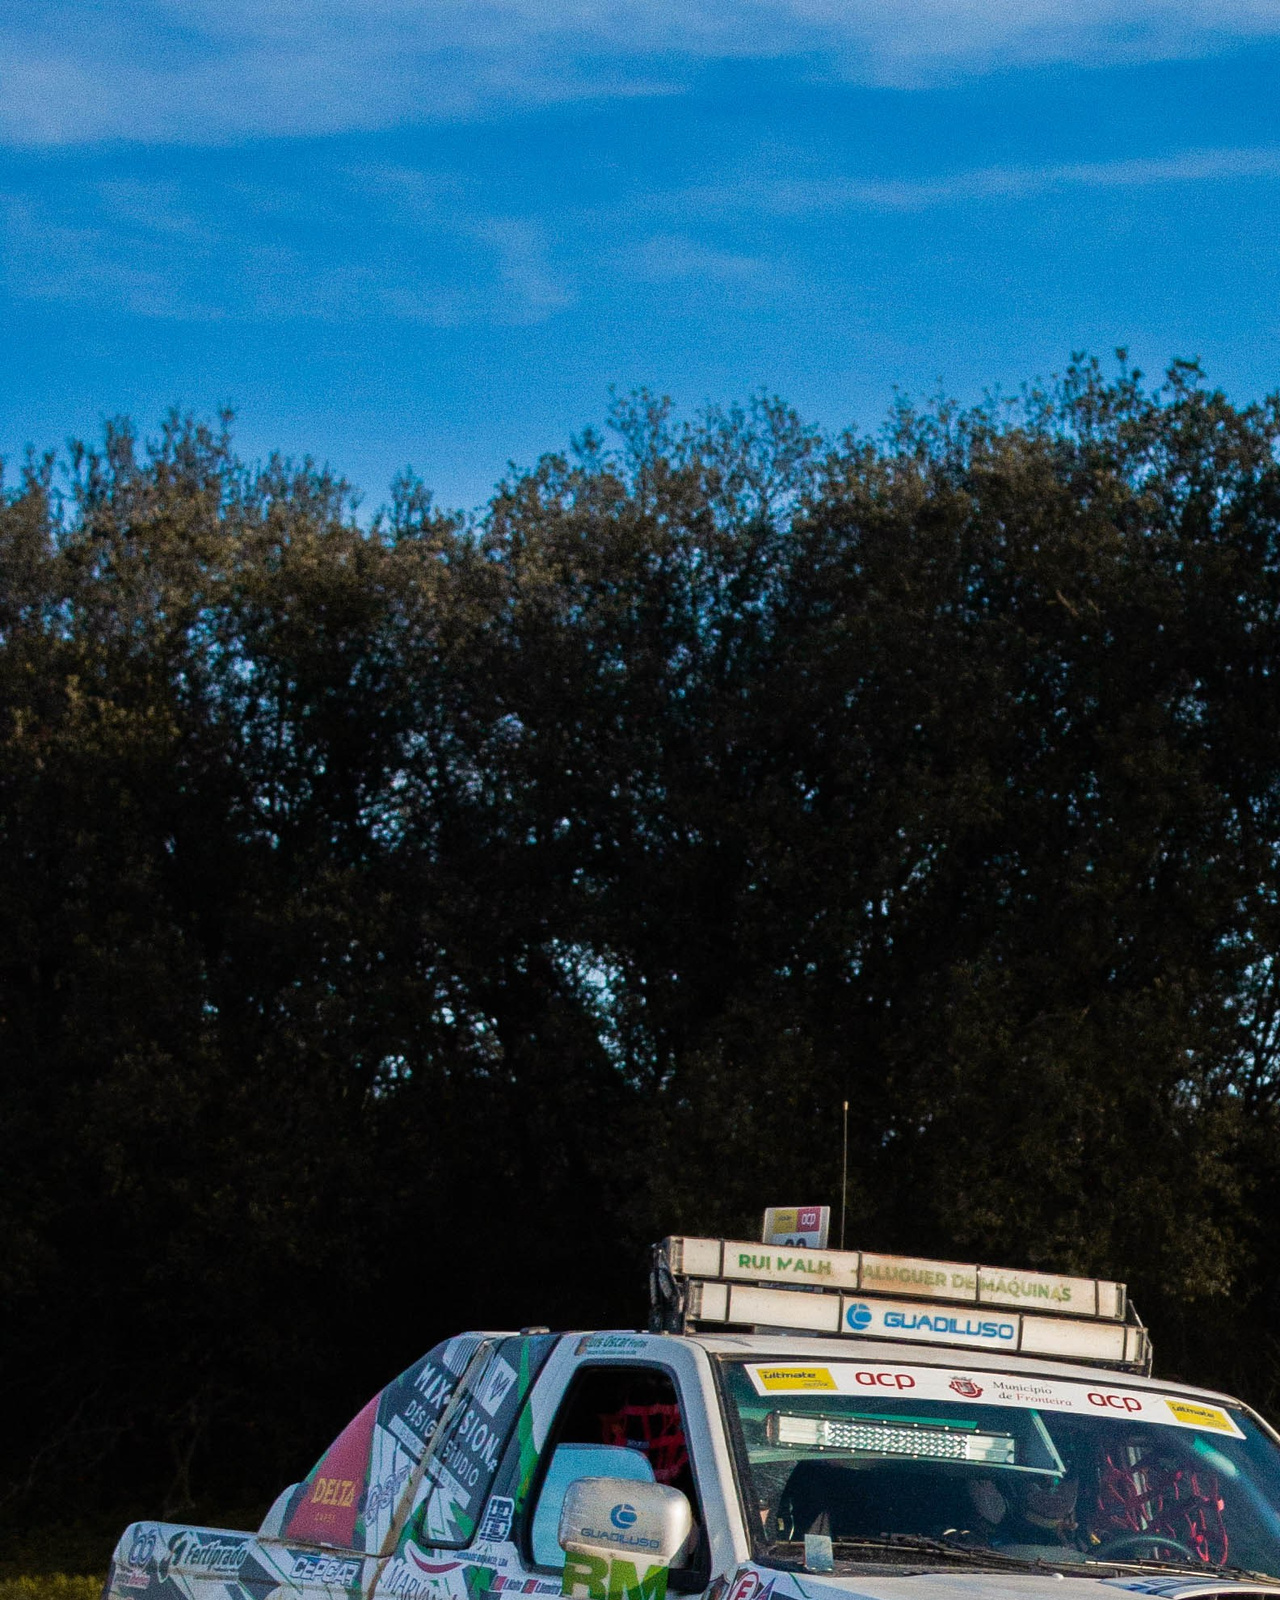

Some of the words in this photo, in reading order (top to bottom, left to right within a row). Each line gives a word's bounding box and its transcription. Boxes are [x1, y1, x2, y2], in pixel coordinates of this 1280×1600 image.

[738, 1253, 771, 1270] RUI
[884, 1311, 1014, 1340] GUADILUSO
[763, 1370, 817, 1380] ultimate
[855, 1371, 916, 1390] acp
[998, 1391, 1013, 1401] de
[1015, 1393, 1073, 1407] Fronteira
[1087, 1392, 1143, 1412] acp
[404, 1400, 438, 1438] DESIG
[580, 1527, 661, 1549] GUADILUSO
[184, 1543, 248, 1571] Fertiprado
